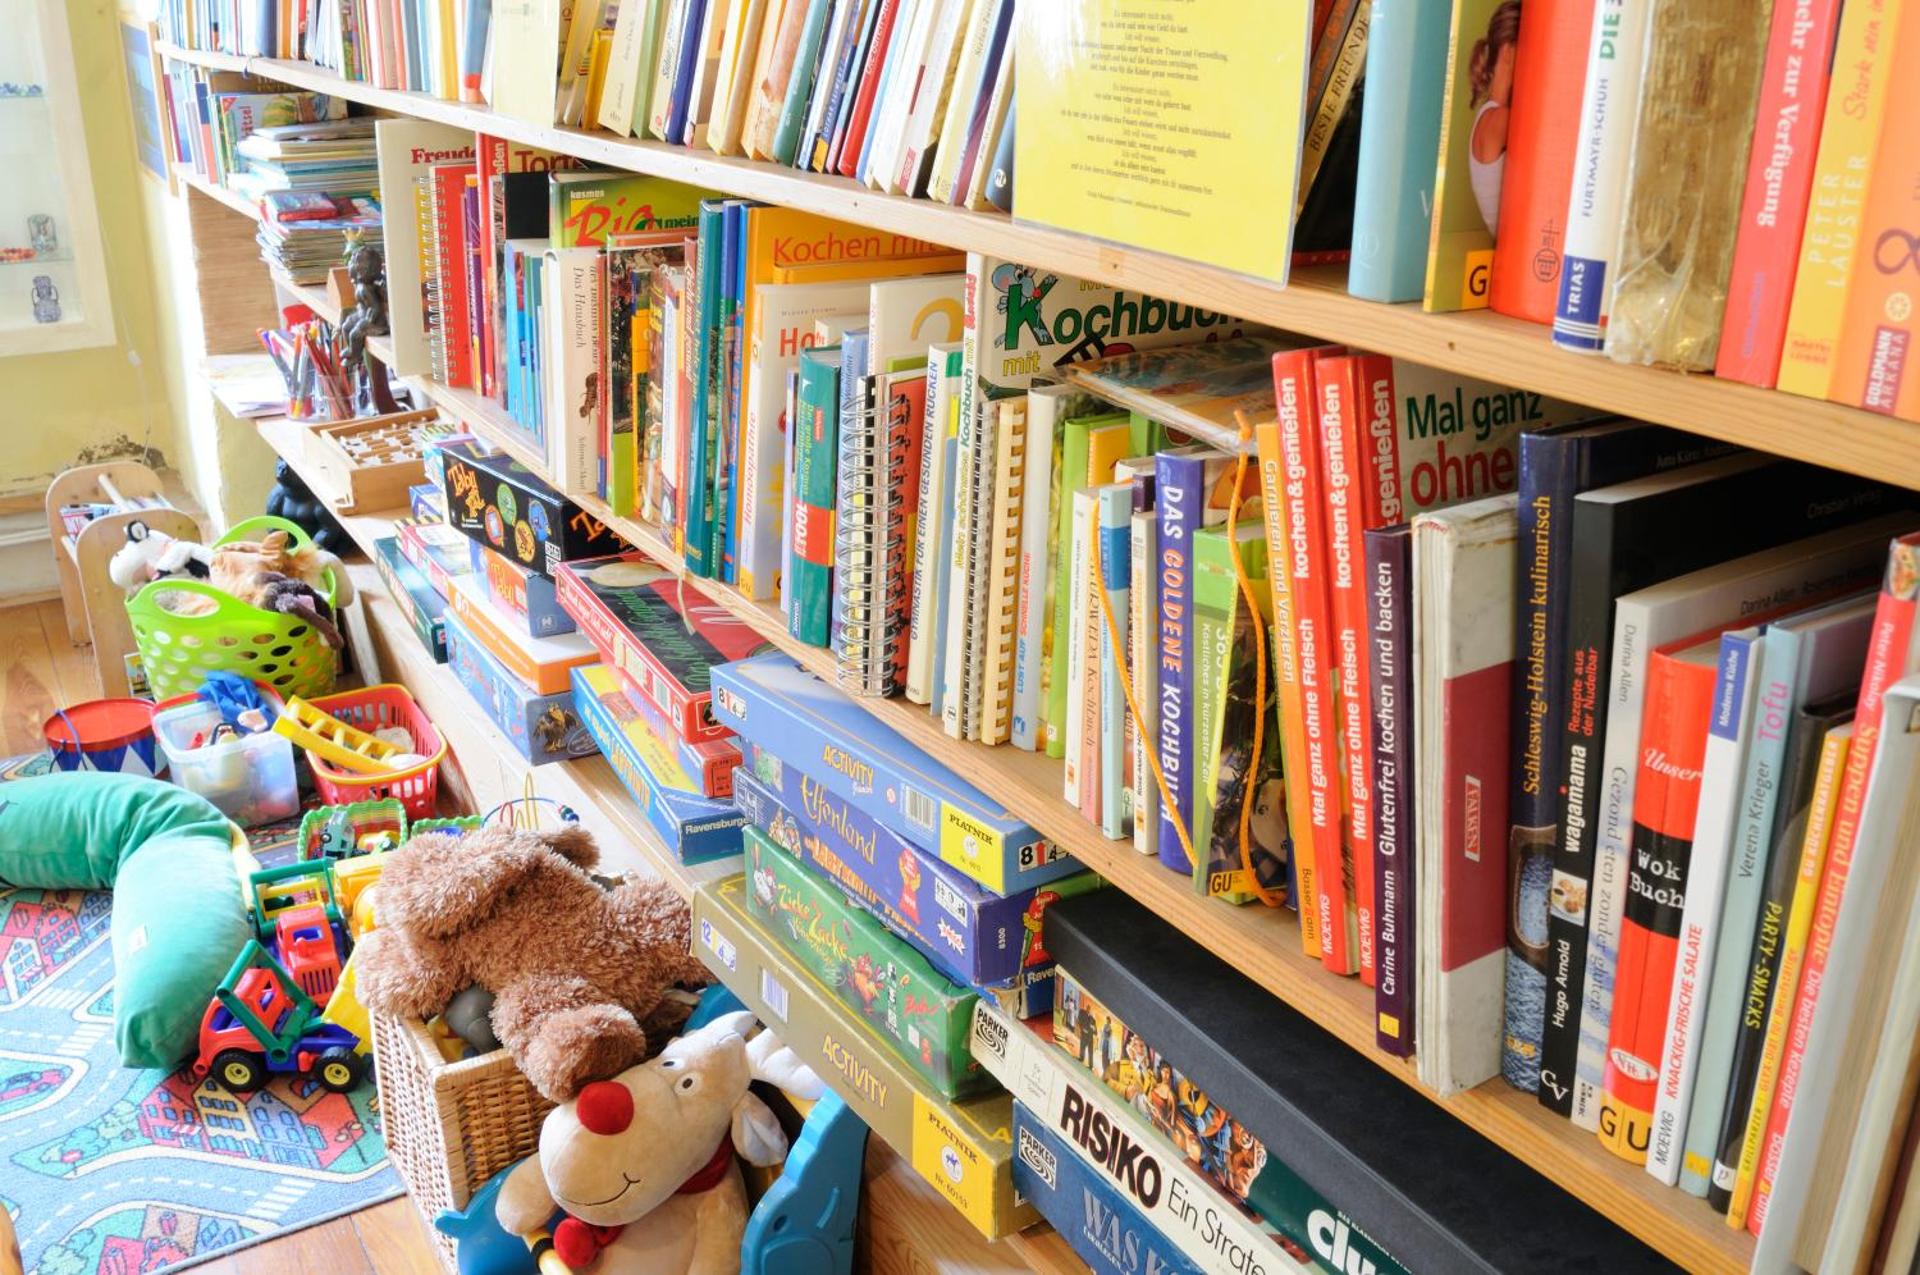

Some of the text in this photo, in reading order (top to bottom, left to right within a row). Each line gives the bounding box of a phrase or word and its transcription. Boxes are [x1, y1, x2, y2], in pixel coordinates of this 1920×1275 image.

[1600, 9, 1622, 60] DIE
[1782, 55, 1805, 97] zur
[1309, 103, 1335, 153] BESTE
[1581, 78, 1609, 217] FURTMAYR-SCHUH
[1757, 103, 1800, 227] Verfügung
[773, 231, 882, 263] Kochen
[1807, 174, 1842, 264] PETER
[1826, 155, 1868, 288] LAUSTER
[1567, 262, 1586, 315] TRIAS
[928, 361, 938, 424] RÜCKEN
[1003, 350, 1041, 377] mit
[1864, 330, 1894, 406] GOLDMANN
[961, 368, 974, 448] Kochbuch
[1280, 377, 1306, 478] genießen
[1322, 383, 1350, 487] genießen
[1406, 387, 1545, 442] Mal ganz
[921, 430, 936, 500] GESUNDEN
[1371, 379, 1401, 519] genießen
[1410, 440, 1515, 507] ohne
[918, 500, 930, 541] EINEN
[1162, 485, 1184, 539] DAS
[1287, 503, 1310, 579] kochen
[1329, 507, 1353, 589] kochen
[910, 575, 926, 642] GYMNASTIK
[1264, 460, 1296, 684] Garnieren und Verzieren
[1162, 548, 1185, 673] GOLDENE
[1523, 494, 1551, 796] Schleswig-Holstein kulinarisch
[1622, 623, 1637, 669] Darina
[1568, 650, 1585, 733] Rezepte aus
[1583, 647, 1599, 736] der Nudelbar
[1718, 649, 1740, 728] Moderne Küche
[1865, 622, 1894, 711] Peter Nikolay
[1301, 618, 1329, 828] Mal ganz ohne Fleisch
[1339, 628, 1368, 841] Mal ganz ohne Fleisch
[1374, 562, 1397, 857] Glutenfrei kochen und backen
[823, 745, 874, 787] ACTIVITY
[1565, 744, 1588, 853] wagamama
[1738, 681, 1789, 879] Verena Krieger Tofu
[1842, 725, 1879, 814] Suppen
[801, 773, 877, 865] Elfenland
[949, 813, 993, 846] PLATNIK
[1020, 845, 1033, 866] 8
[1465, 786, 1481, 853] FALKEN
[1833, 819, 1855, 866] und
[1211, 872, 1233, 894] GU
[1603, 846, 1619, 889] eten
[1629, 872, 1687, 911] Buch
[1637, 848, 1682, 882] Wok
[1319, 893, 1334, 956] MOEWIG
[1360, 906, 1374, 970] MOEWIG
[1380, 869, 1396, 996] Carine Buhmann
[1598, 891, 1614, 948] zonder
[1551, 940, 1571, 1028] Hugo Arnold
[978, 1008, 1010, 1041] PARKER
[1654, 922, 1703, 1166] MOEWIG KNACKIG-FRISCHE SALATE
[1779, 967, 1821, 1108] Die besten Rezepte
[822, 1034, 889, 1109] ACTIVITY
[928, 1111, 979, 1166] PLATNIK
[1019, 1129, 1057, 1168] PARKER
[1060, 1083, 1163, 1210] RISIKO
[1167, 1177, 1199, 1231] Ein
[1599, 1105, 1651, 1151] GU
[1083, 1187, 1142, 1272] WAS
